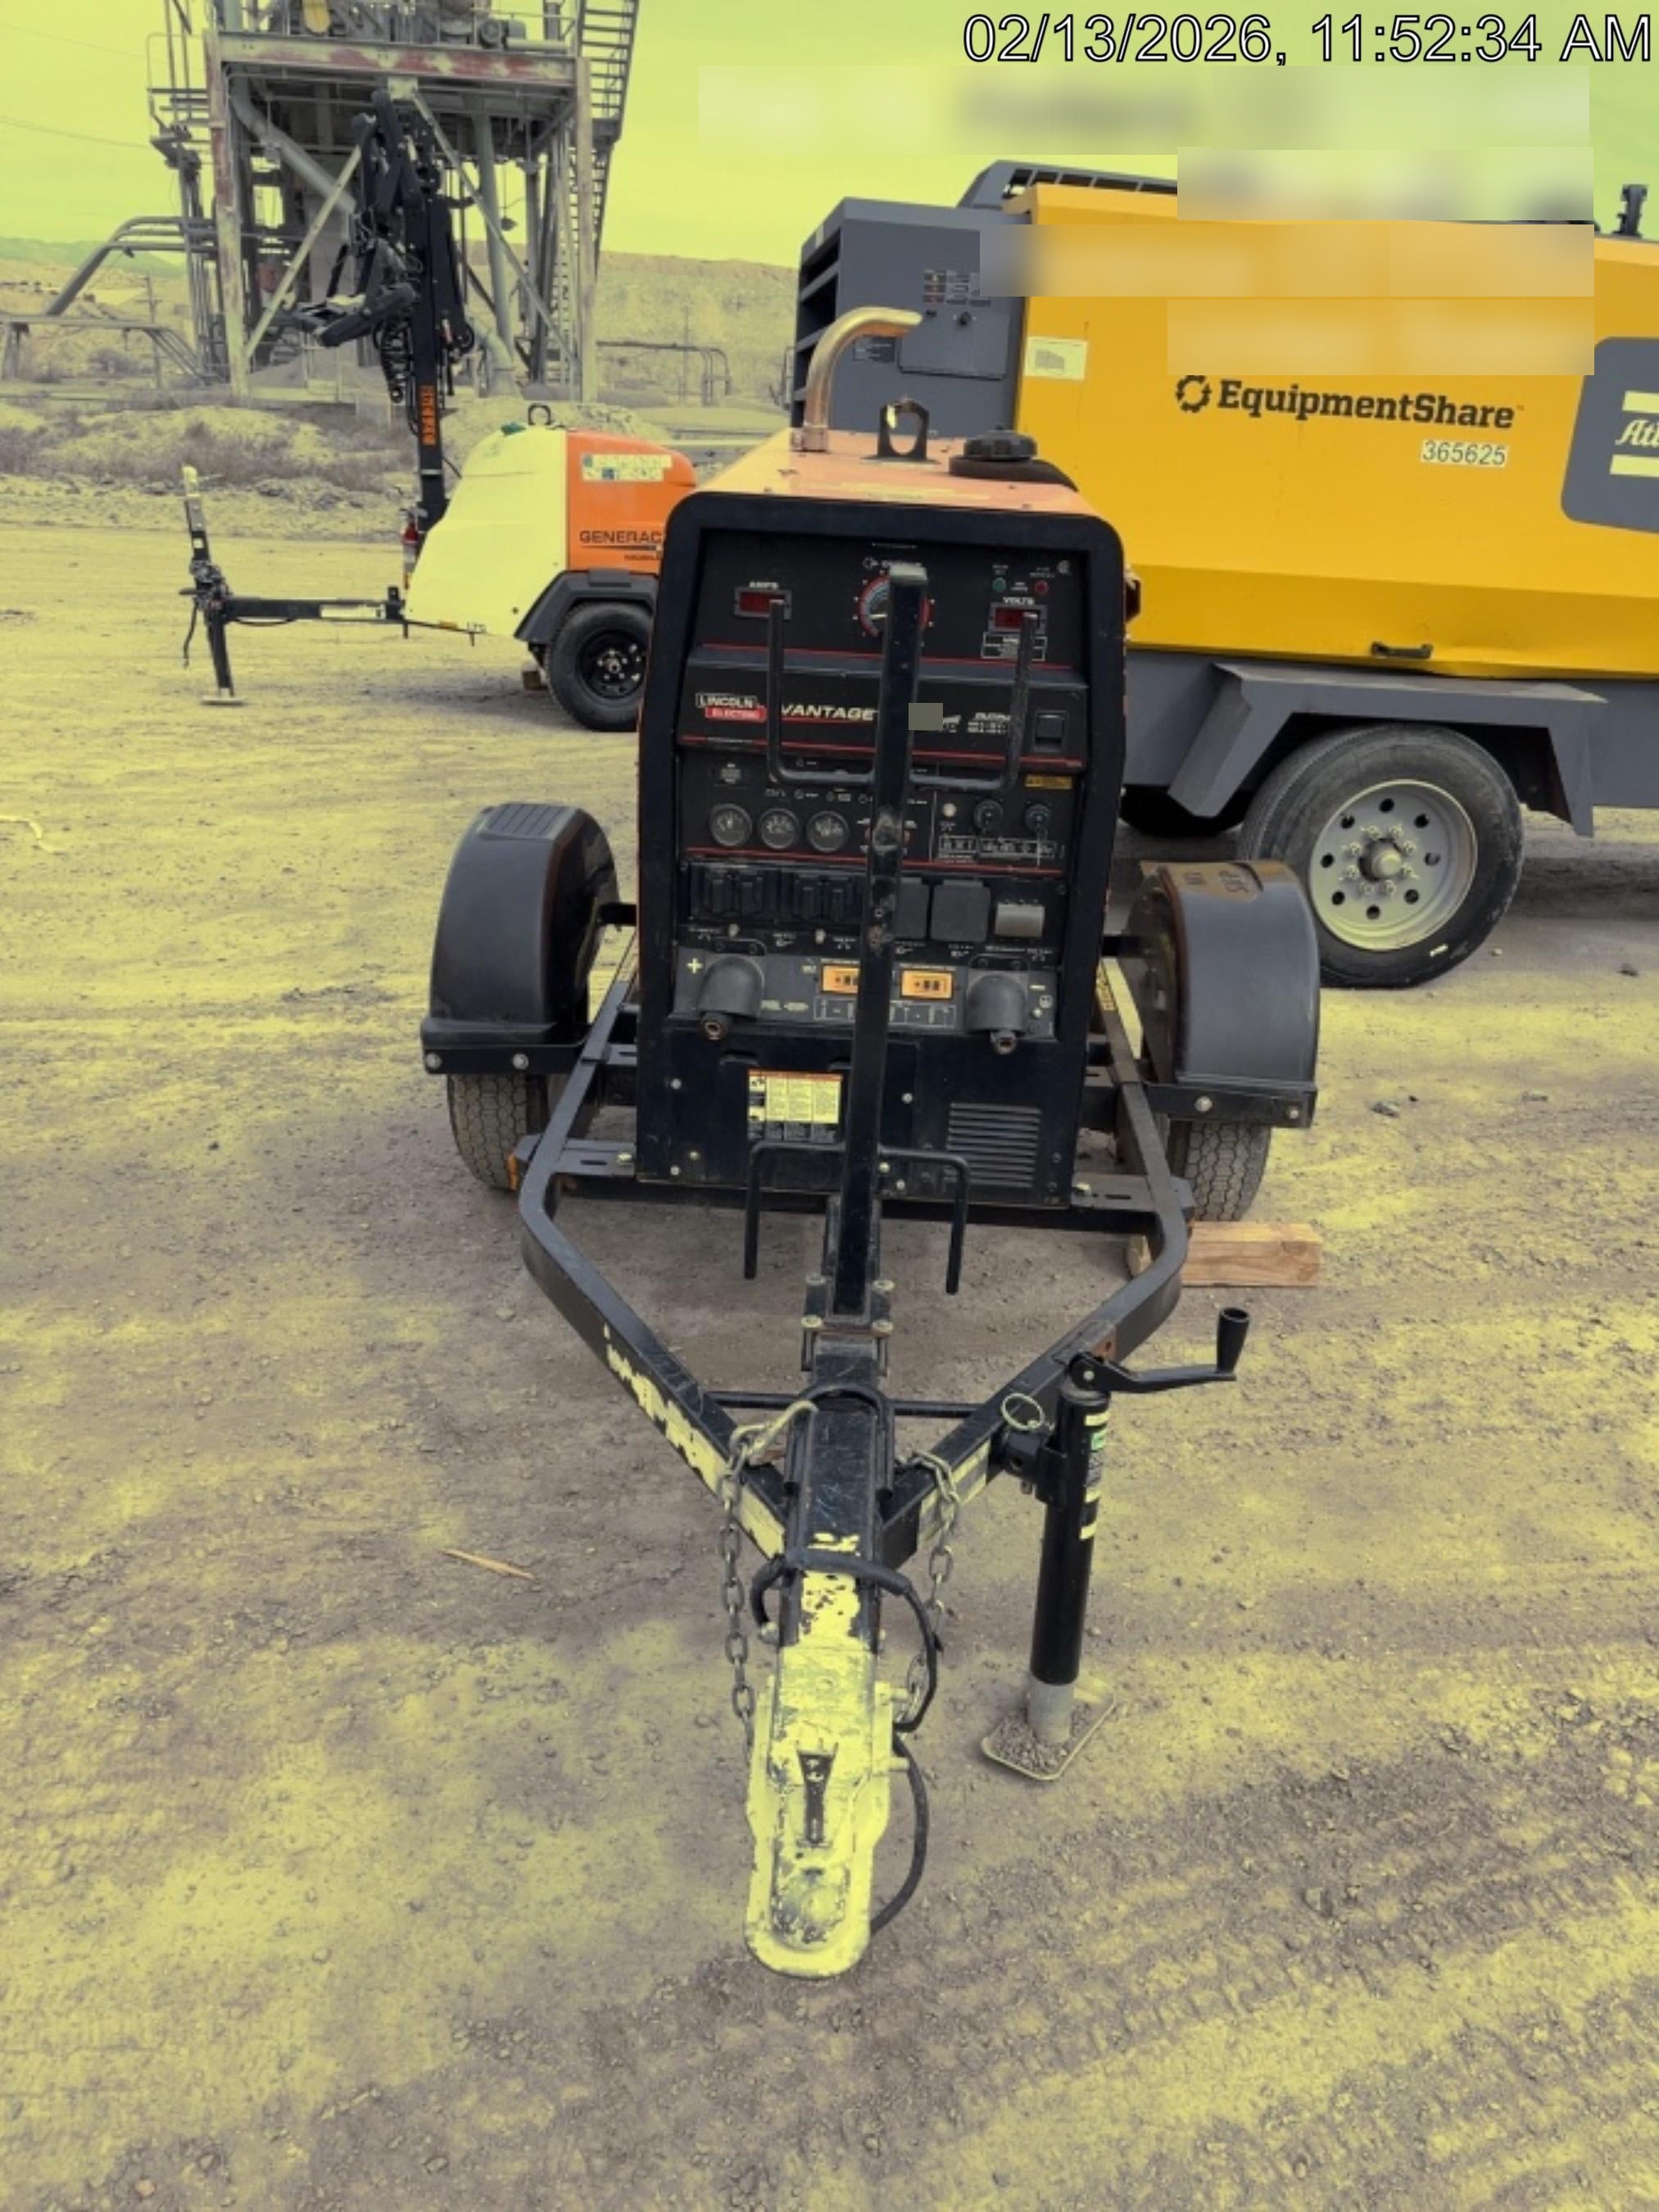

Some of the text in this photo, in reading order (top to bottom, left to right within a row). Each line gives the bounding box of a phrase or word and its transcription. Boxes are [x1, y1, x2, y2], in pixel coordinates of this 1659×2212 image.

[1217, 378, 1515, 429] EquipmentShare
[1423, 439, 1506, 466] 365625
[700, 695, 755, 707] LINCOLN
[781, 703, 876, 720] VANTAGE
